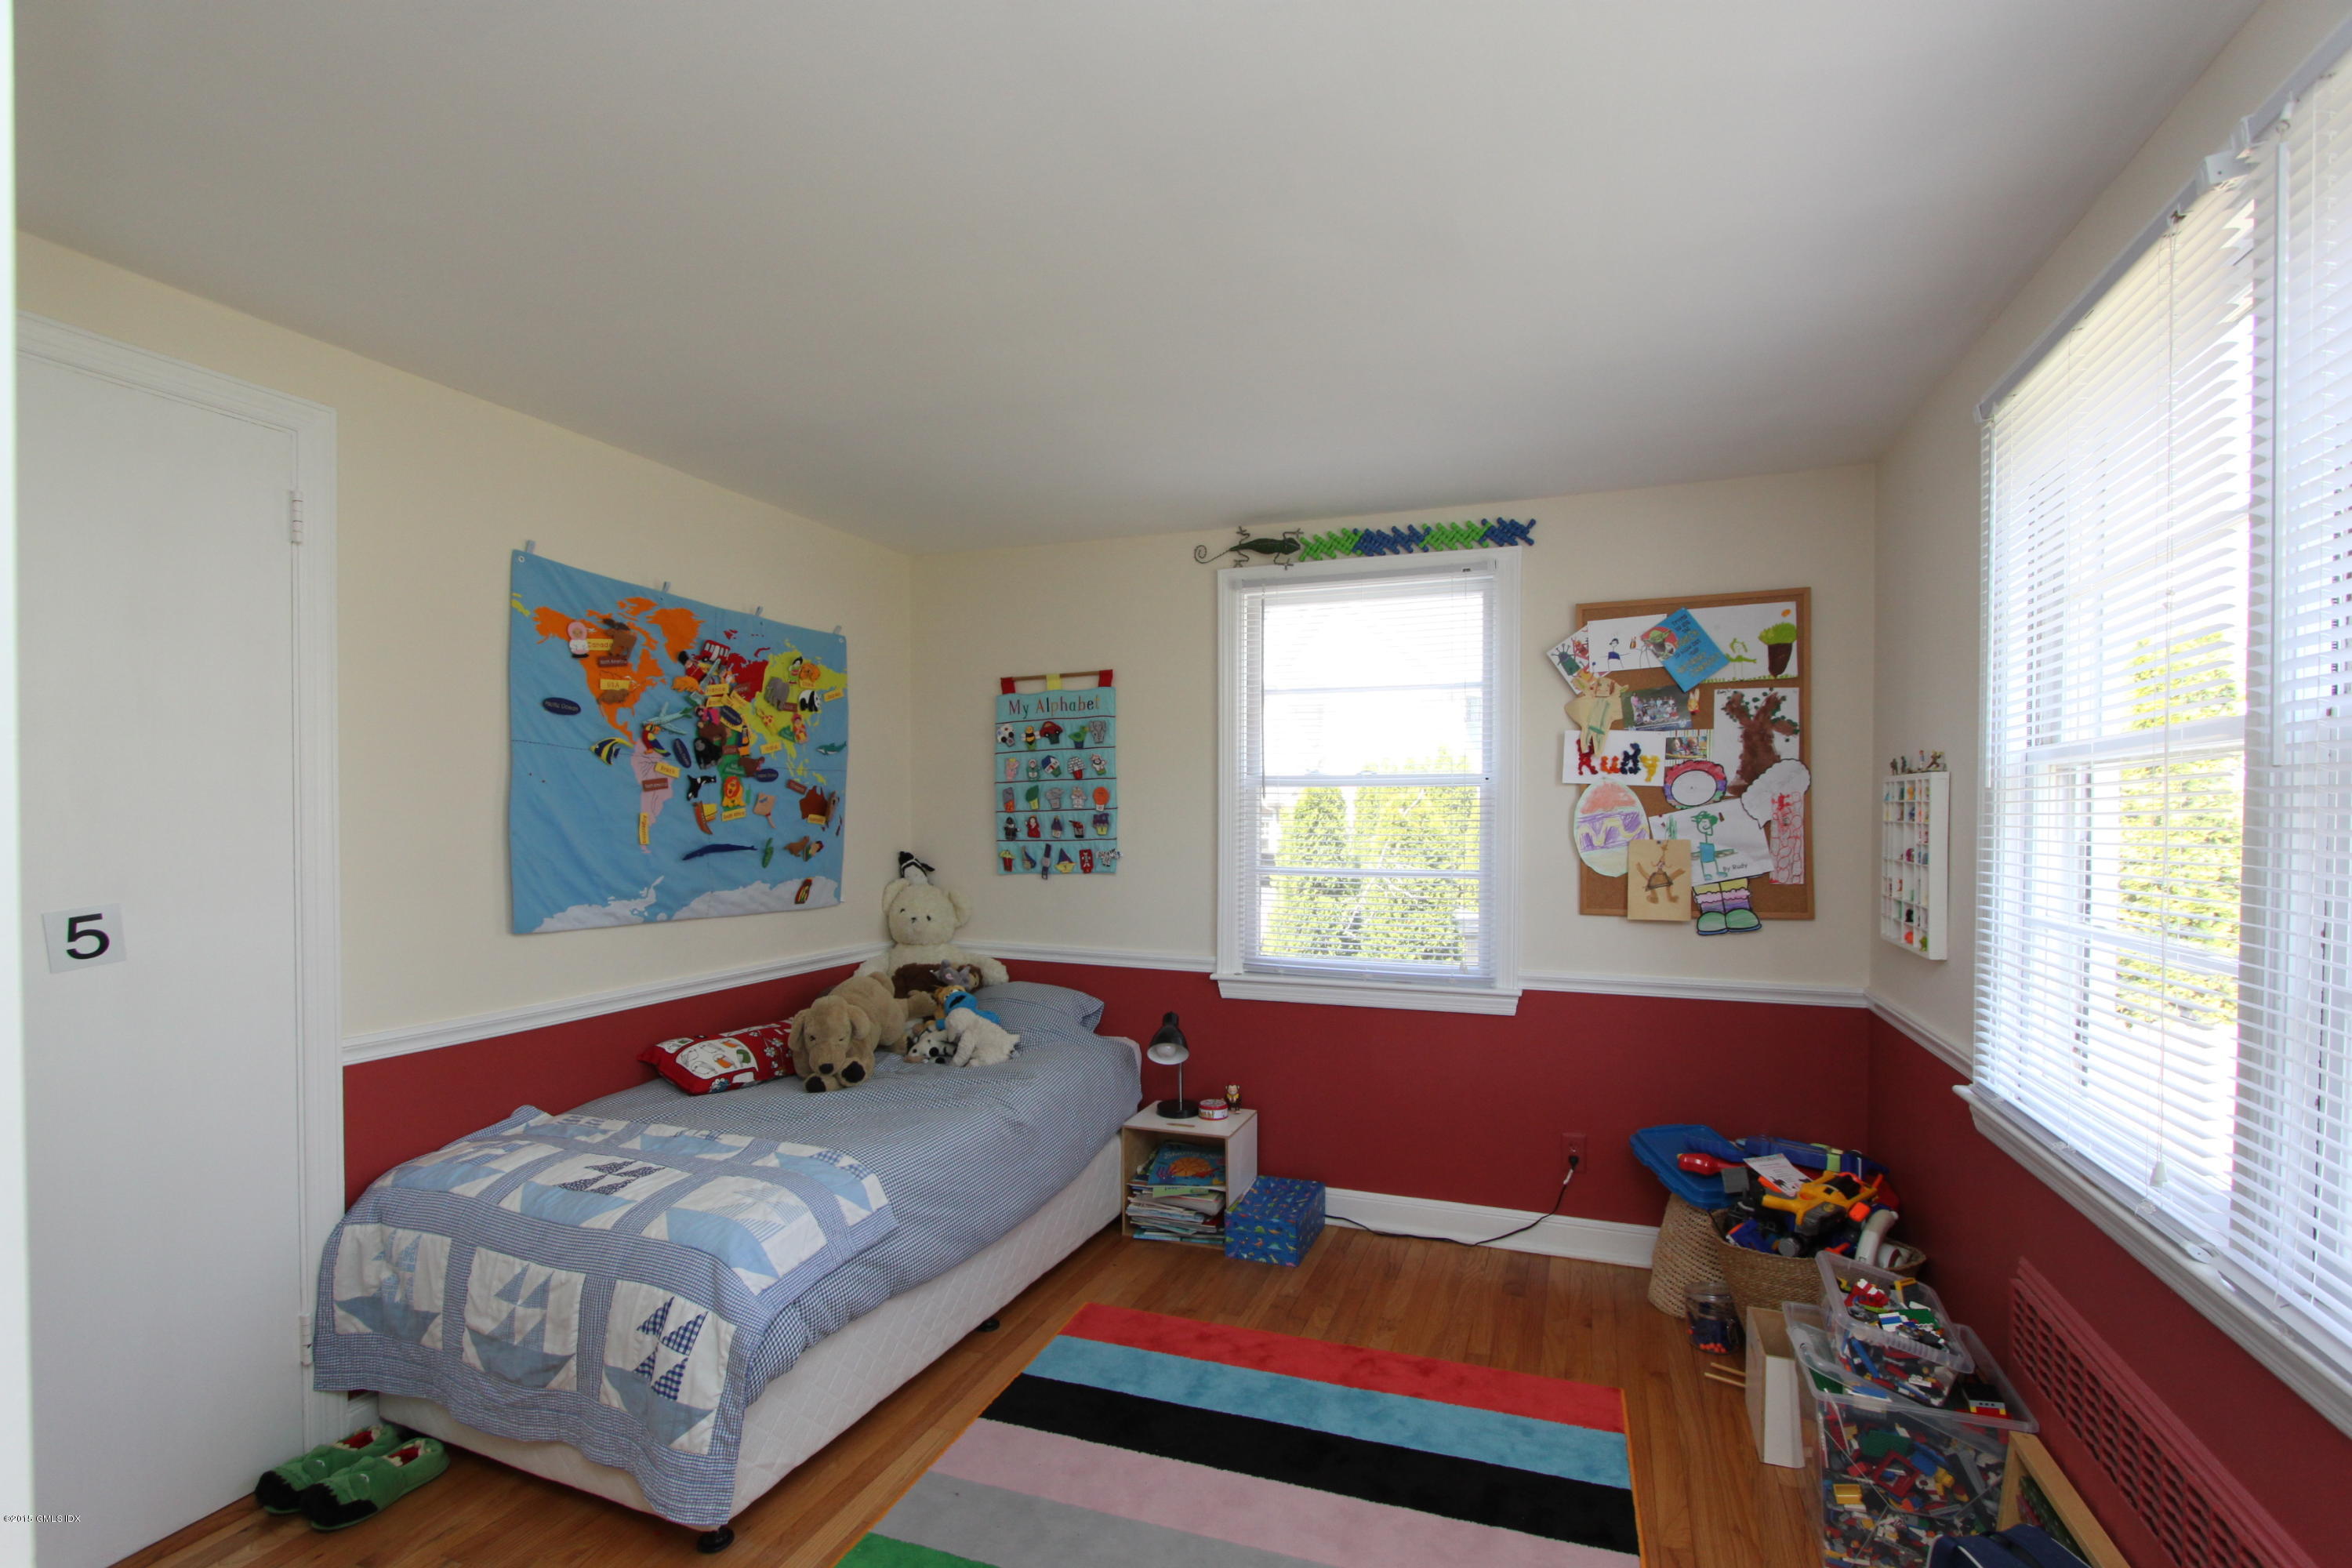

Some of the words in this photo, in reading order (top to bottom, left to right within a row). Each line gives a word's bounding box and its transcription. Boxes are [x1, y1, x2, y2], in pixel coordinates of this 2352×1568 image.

[1009, 699, 1029, 720] My
[1036, 694, 1101, 717] Alphabet
[67, 913, 110, 960] 5
